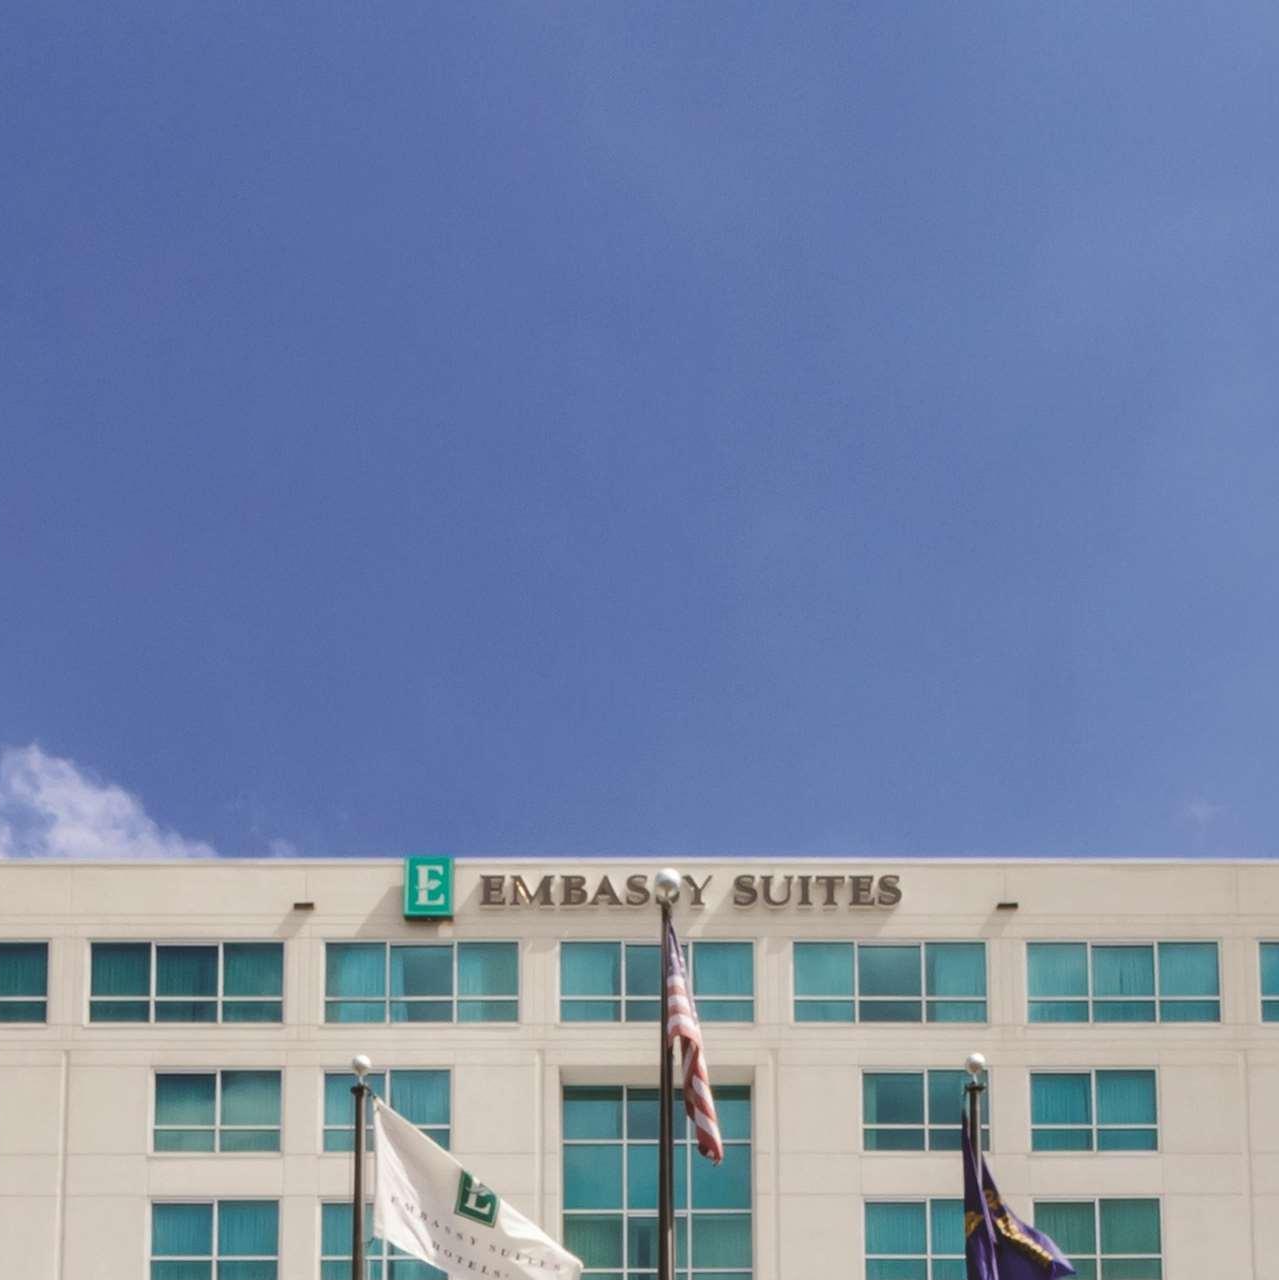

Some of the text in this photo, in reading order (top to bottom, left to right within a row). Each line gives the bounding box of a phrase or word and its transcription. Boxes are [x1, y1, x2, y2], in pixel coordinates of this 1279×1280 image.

[415, 864, 445, 906] E
[479, 874, 903, 906] EMBASY SUITES
